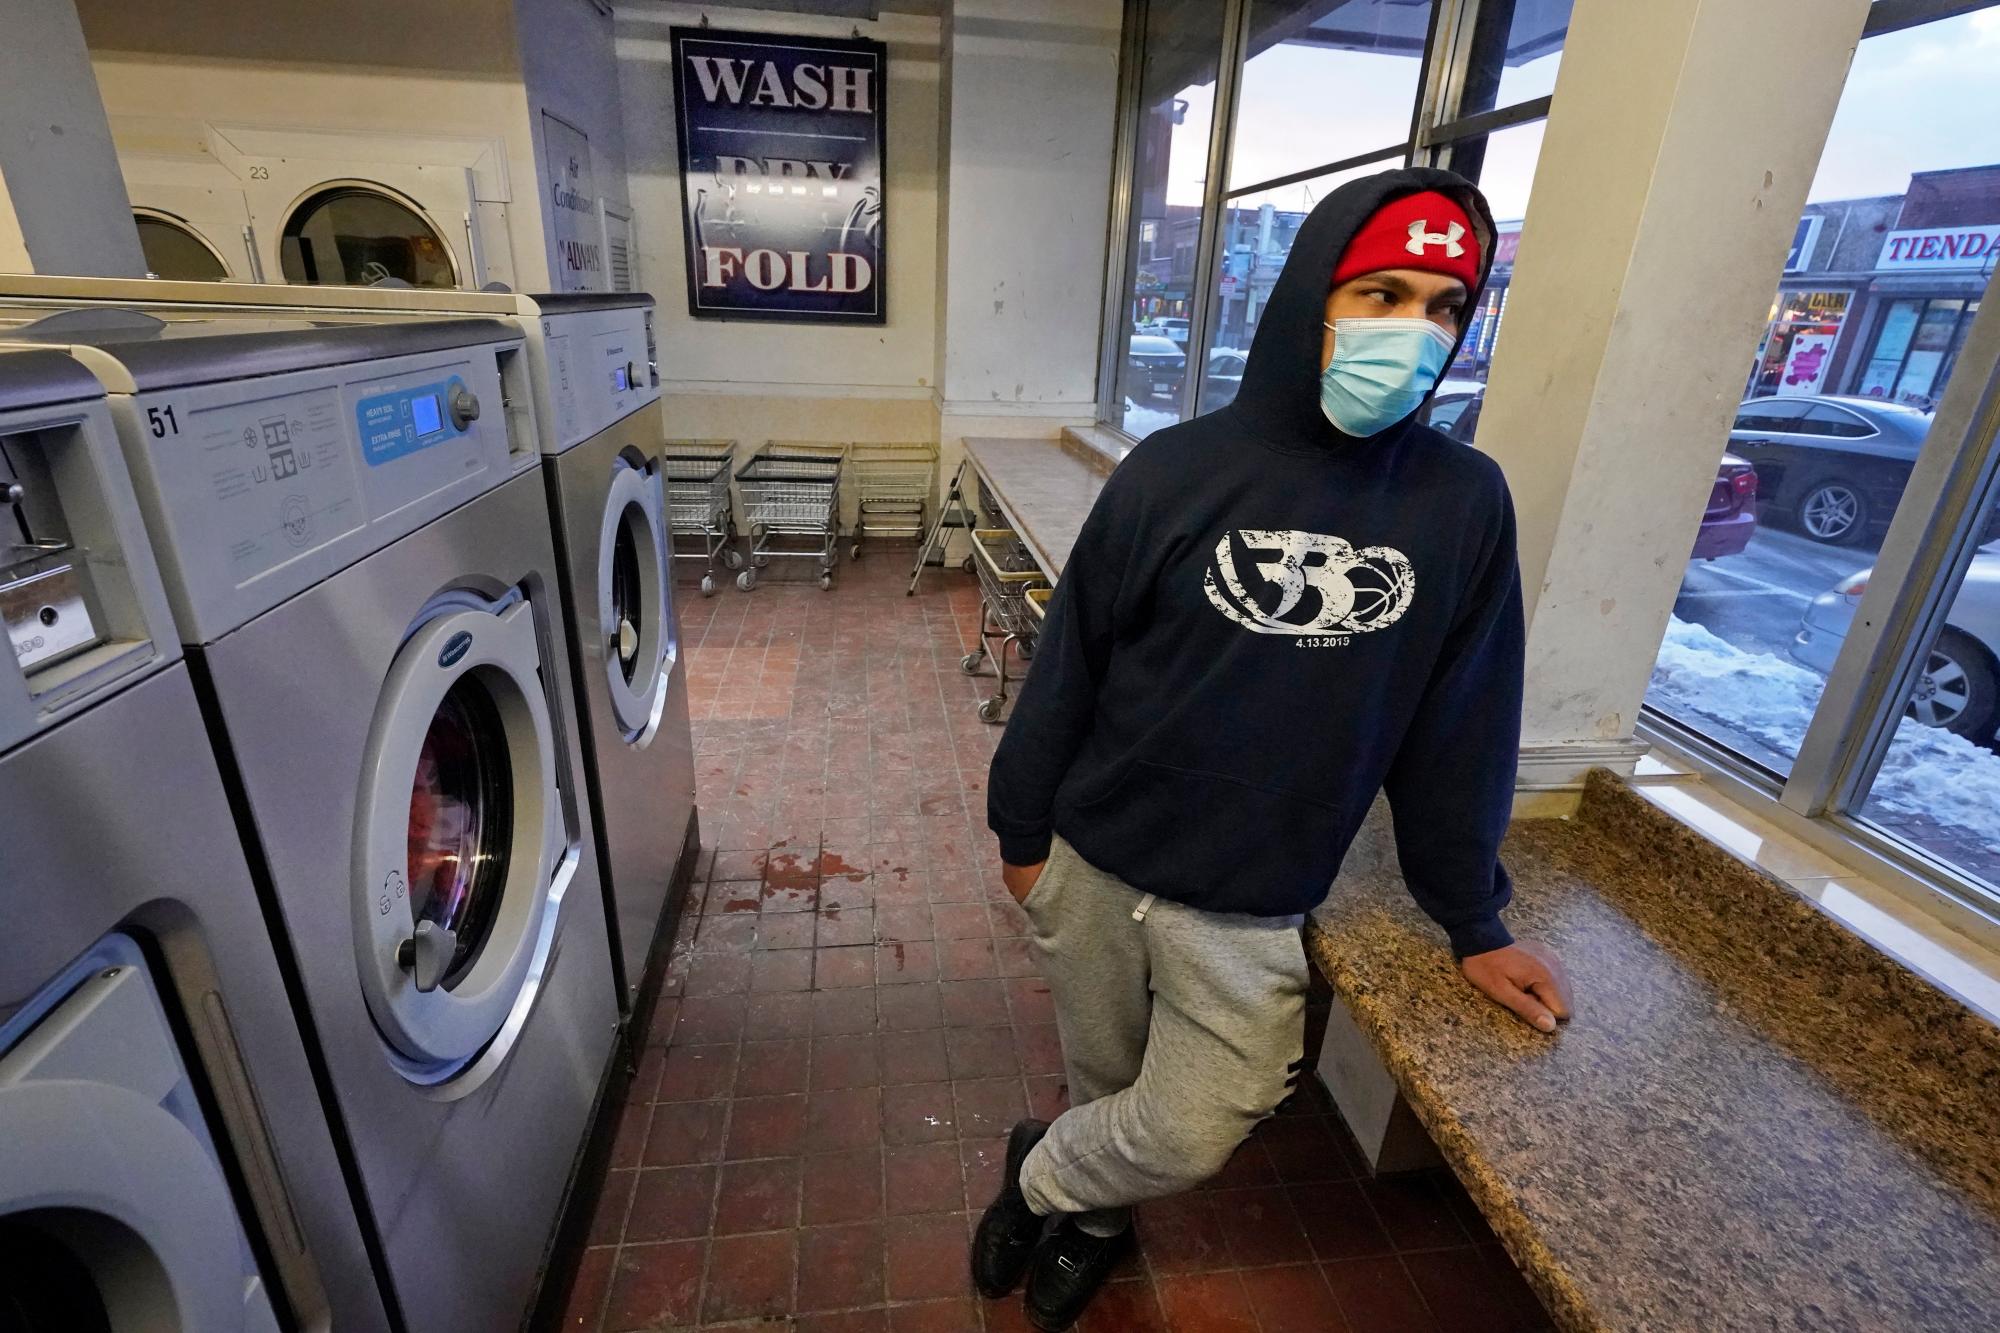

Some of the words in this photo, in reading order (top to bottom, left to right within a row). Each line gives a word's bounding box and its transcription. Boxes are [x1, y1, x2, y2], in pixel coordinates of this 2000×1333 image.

[687, 55, 873, 113] WASH
[249, 166, 269, 180] 23
[701, 246, 872, 294] FOLD
[147, 404, 179, 438] 51
[1295, 636, 1350, 648] 4.13.2019
